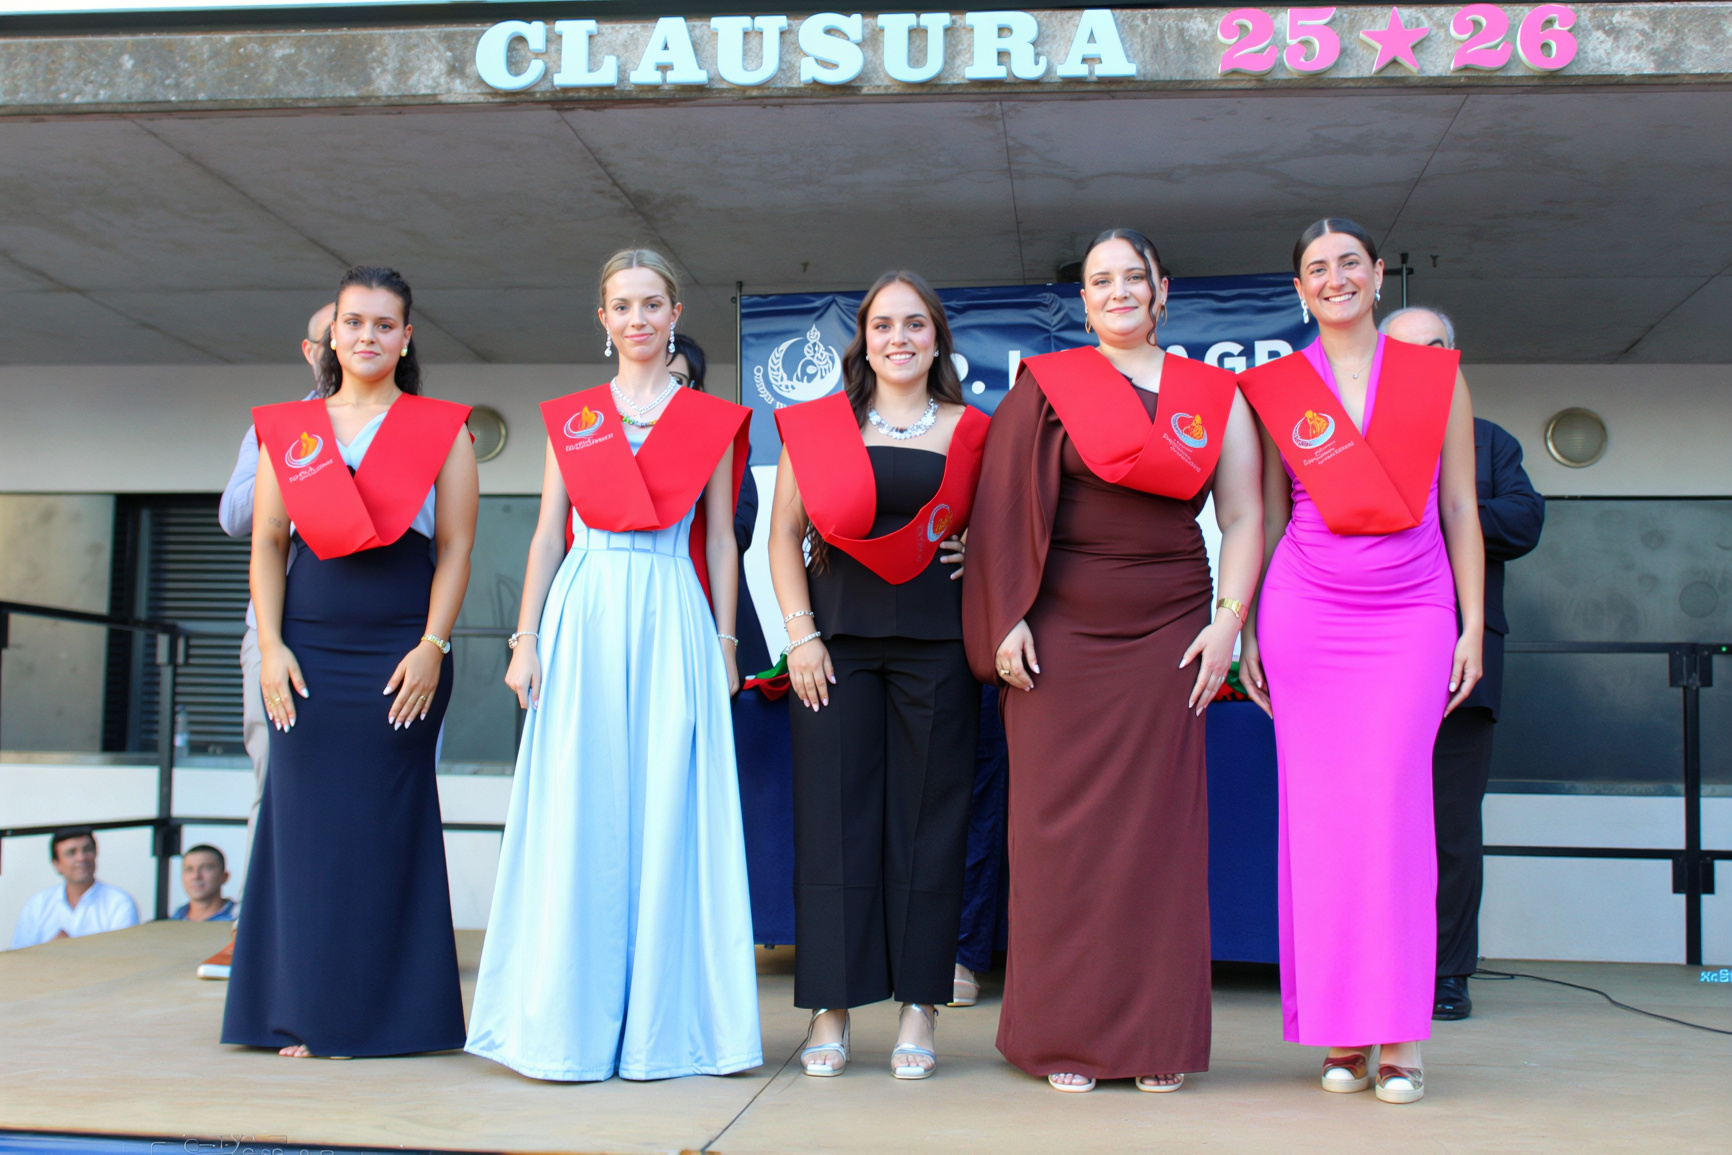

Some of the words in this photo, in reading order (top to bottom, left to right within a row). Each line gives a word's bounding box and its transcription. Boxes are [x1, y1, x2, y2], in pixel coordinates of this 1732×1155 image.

[475, 9, 1137, 91] CLAUSURA
[1217, 6, 1341, 75] 25
[1450, 3, 1578, 71] 26
